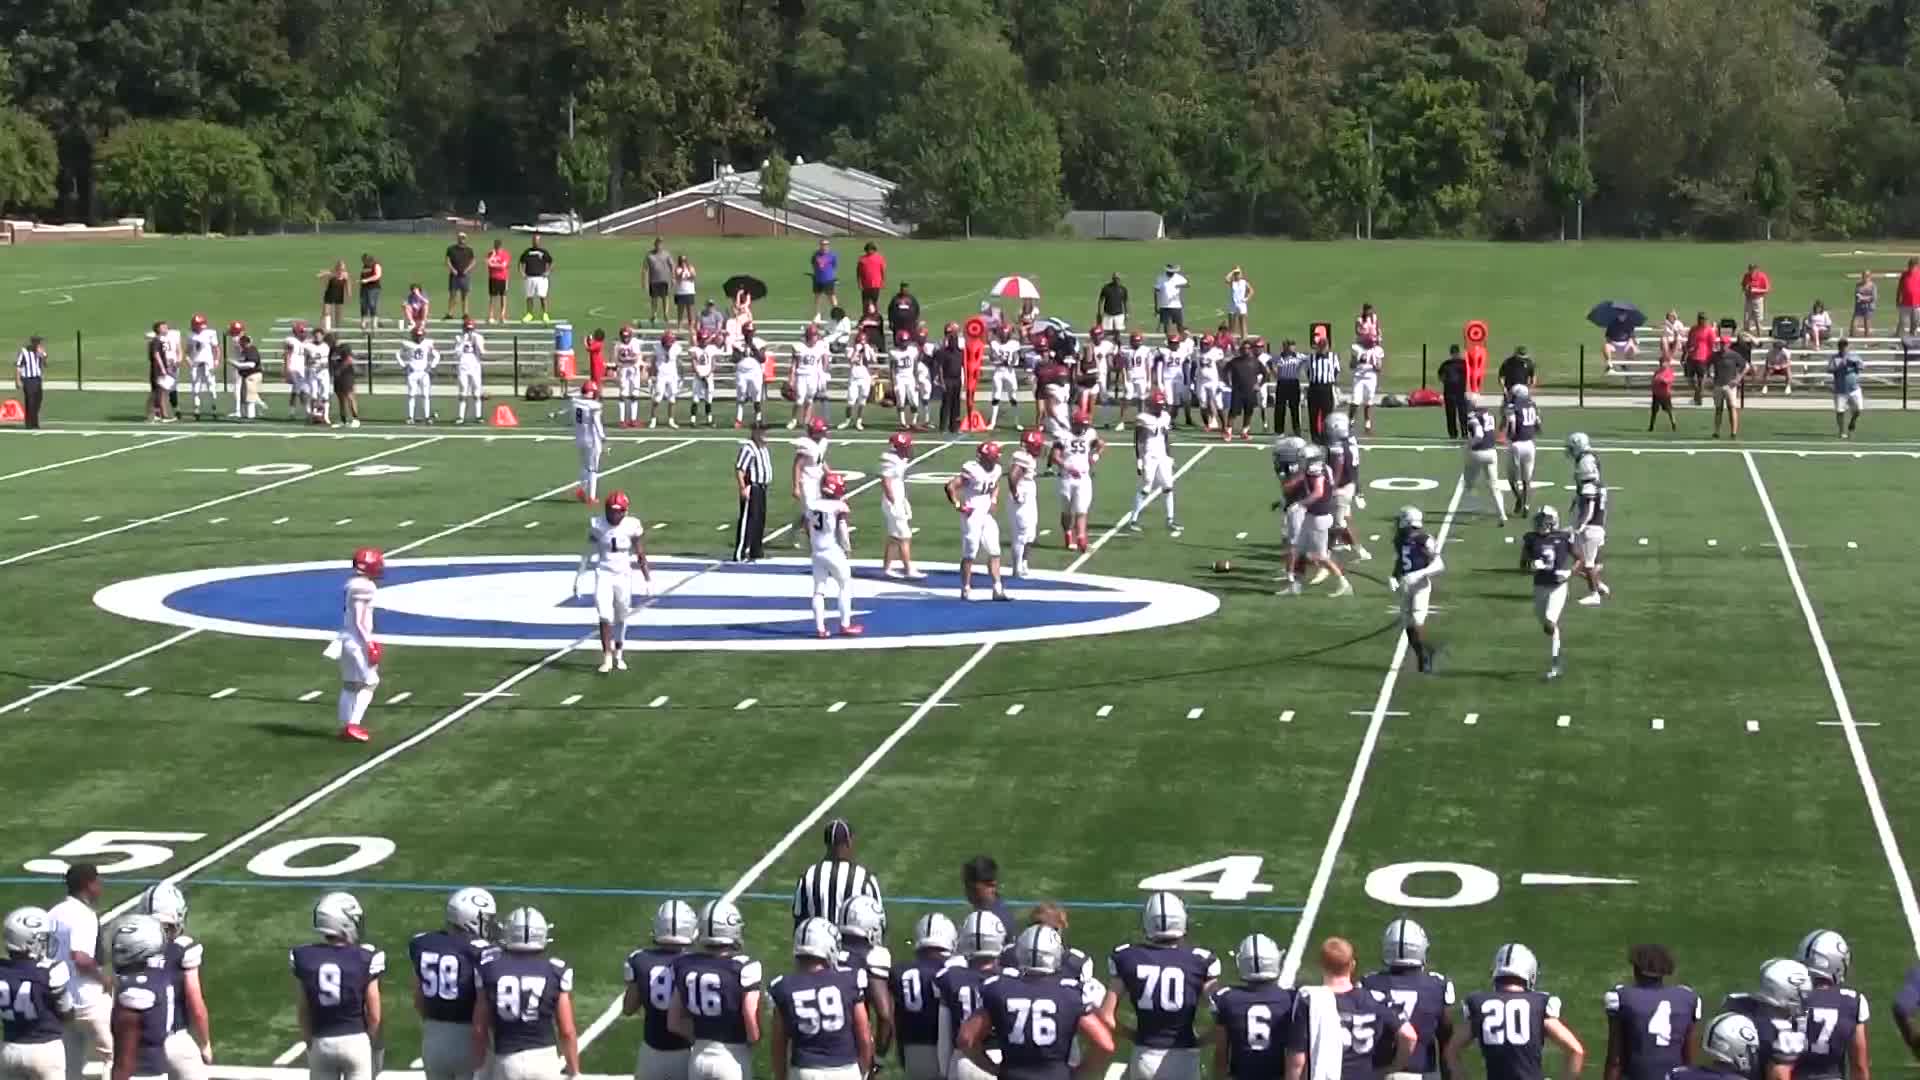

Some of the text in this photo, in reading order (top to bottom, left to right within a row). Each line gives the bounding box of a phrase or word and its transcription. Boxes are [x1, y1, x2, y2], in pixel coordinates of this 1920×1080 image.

[318, 963, 342, 1007] 9
[686, 971, 721, 1016] 16
[1136, 965, 1186, 1011] 70
[792, 985, 843, 1035] 59
[1006, 997, 1057, 1047] 76
[1247, 1004, 1271, 1051] 6
[1481, 998, 1530, 1045] 20
[1648, 1000, 1672, 1046] 4
